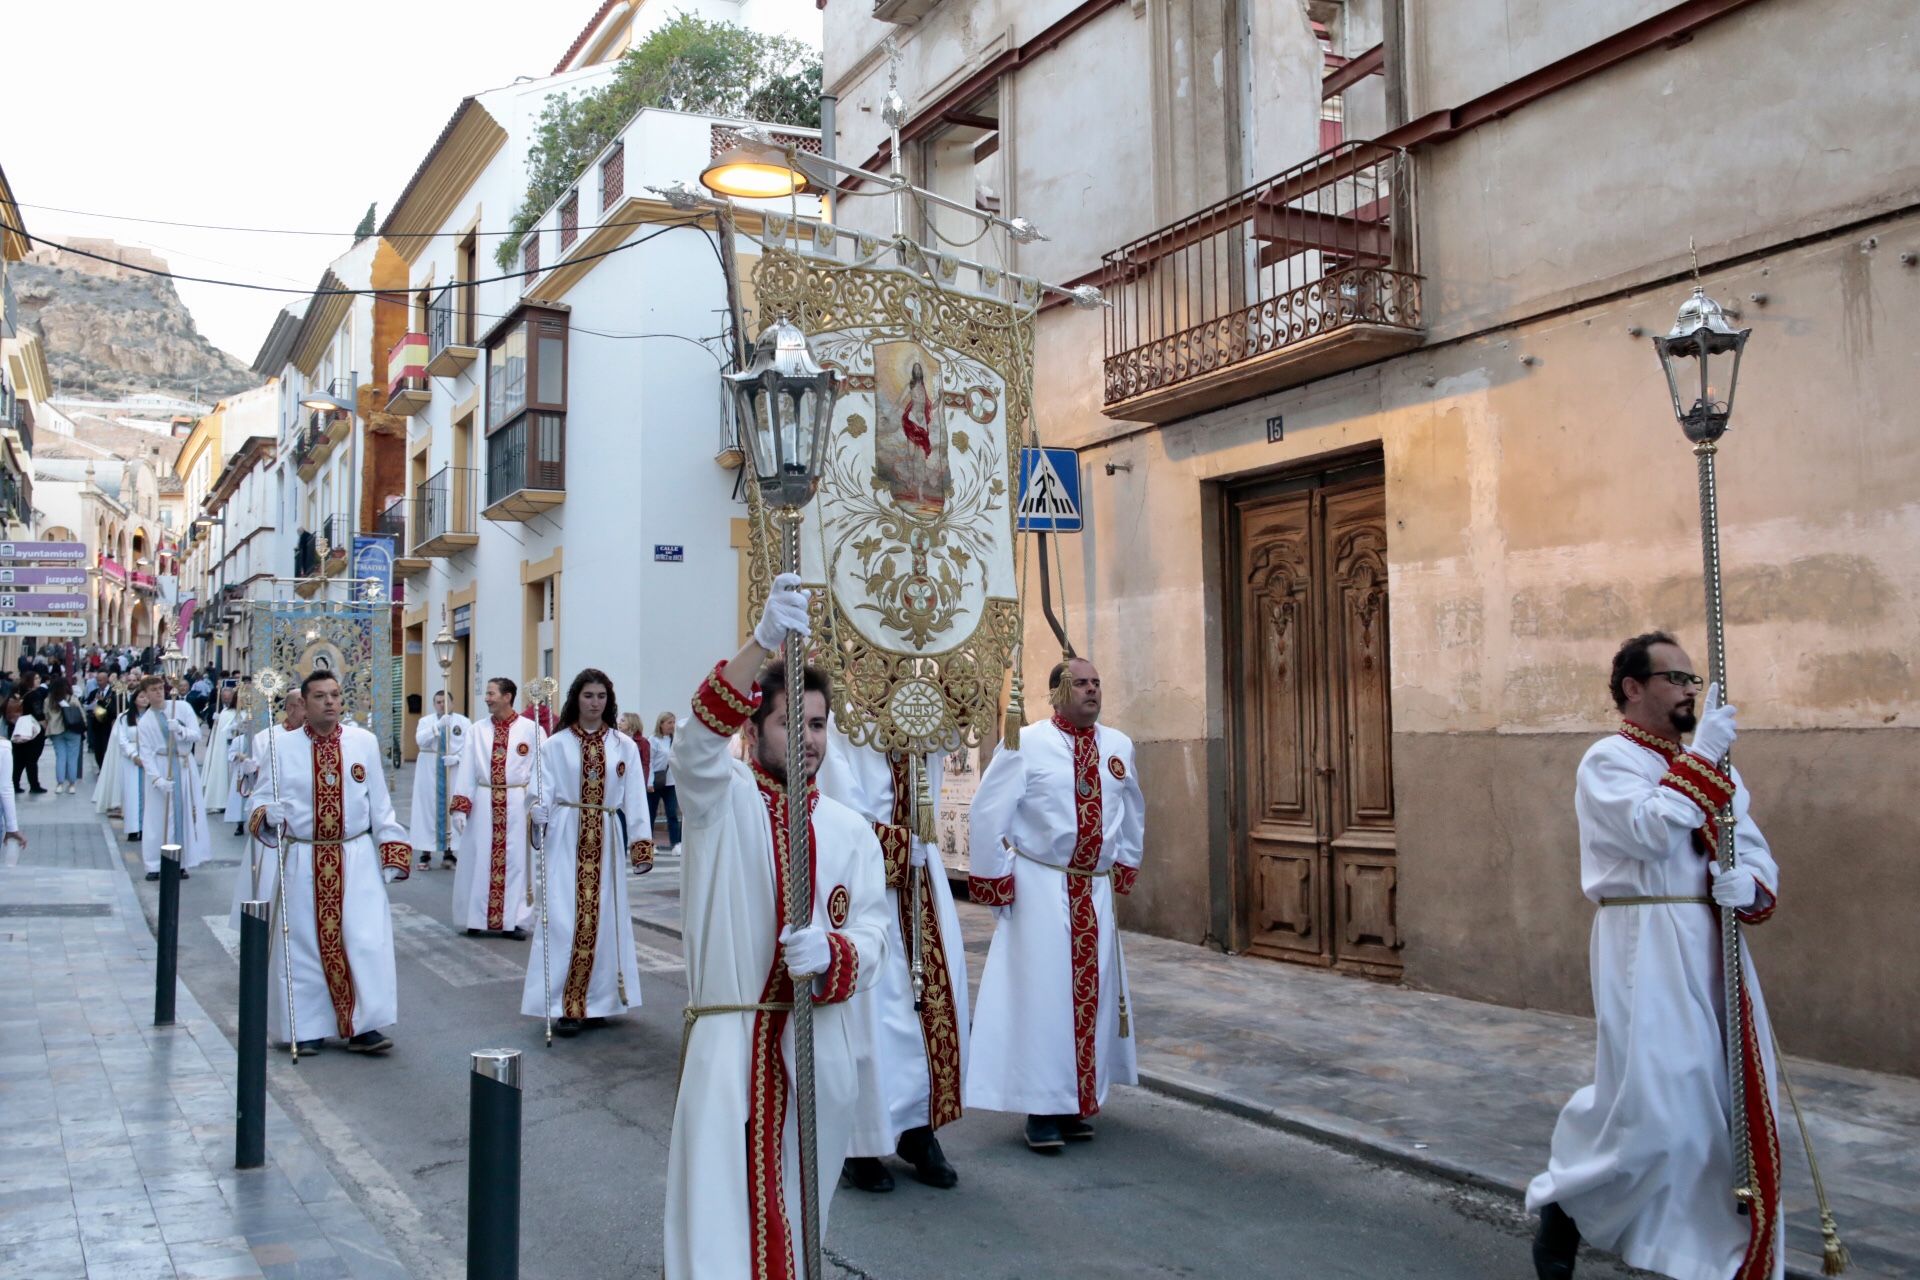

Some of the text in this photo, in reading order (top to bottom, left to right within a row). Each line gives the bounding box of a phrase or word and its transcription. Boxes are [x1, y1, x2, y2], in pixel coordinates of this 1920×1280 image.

[1269, 420, 1281, 441] 15
[16, 550, 84, 559] ayuntamiento
[45, 575, 85, 584] juzgado
[48, 601, 85, 609] castillo
